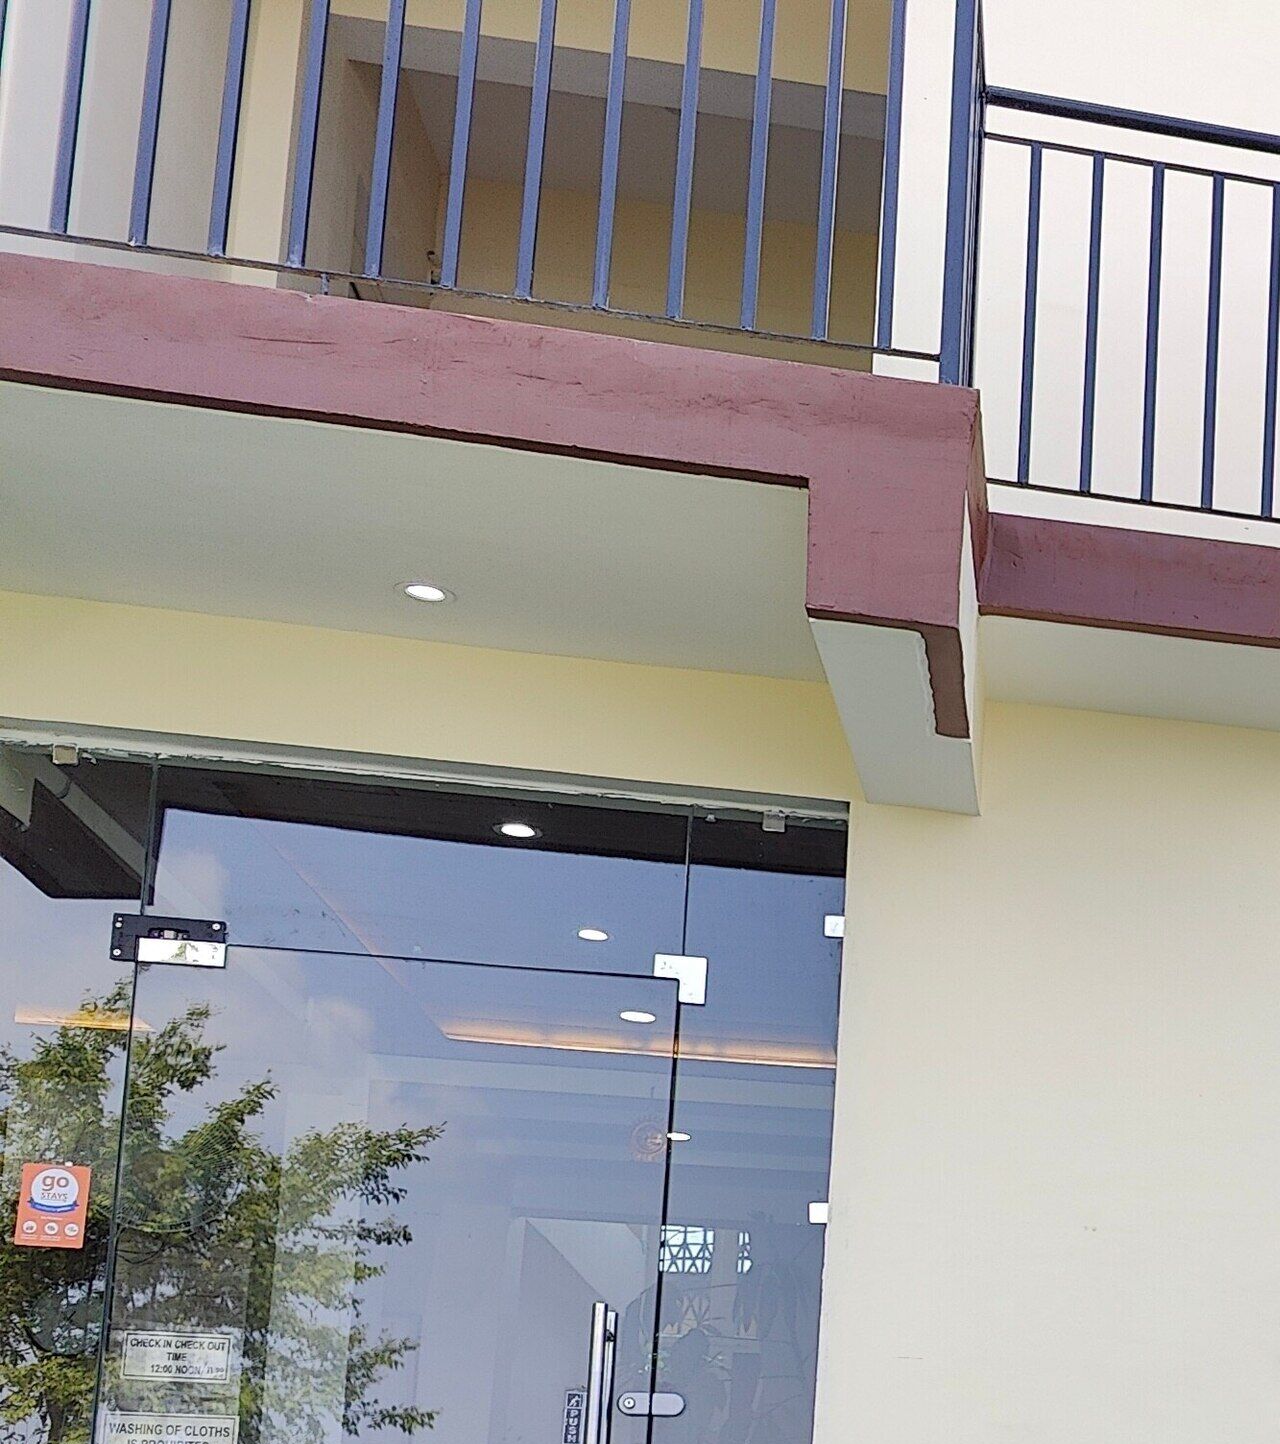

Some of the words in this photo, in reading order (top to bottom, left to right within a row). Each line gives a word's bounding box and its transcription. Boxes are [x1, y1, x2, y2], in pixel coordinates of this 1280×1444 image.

[42, 1176, 69, 1191] go
[41, 1192, 68, 1200] STAYS
[130, 1338, 161, 1348] CHECK
[163, 1340, 171, 1348] IN
[174, 1340, 204, 1350] CHECK
[207, 1341, 226, 1352] OUT
[167, 1352, 187, 1361] TIME
[151, 1364, 172, 1374] 12:00
[109, 1423, 163, 1435] WASHING
[166, 1425, 182, 1435] OF
[184, 1426, 230, 1438] CLOTHS
[567, 1410, 579, 1443] PUSH
